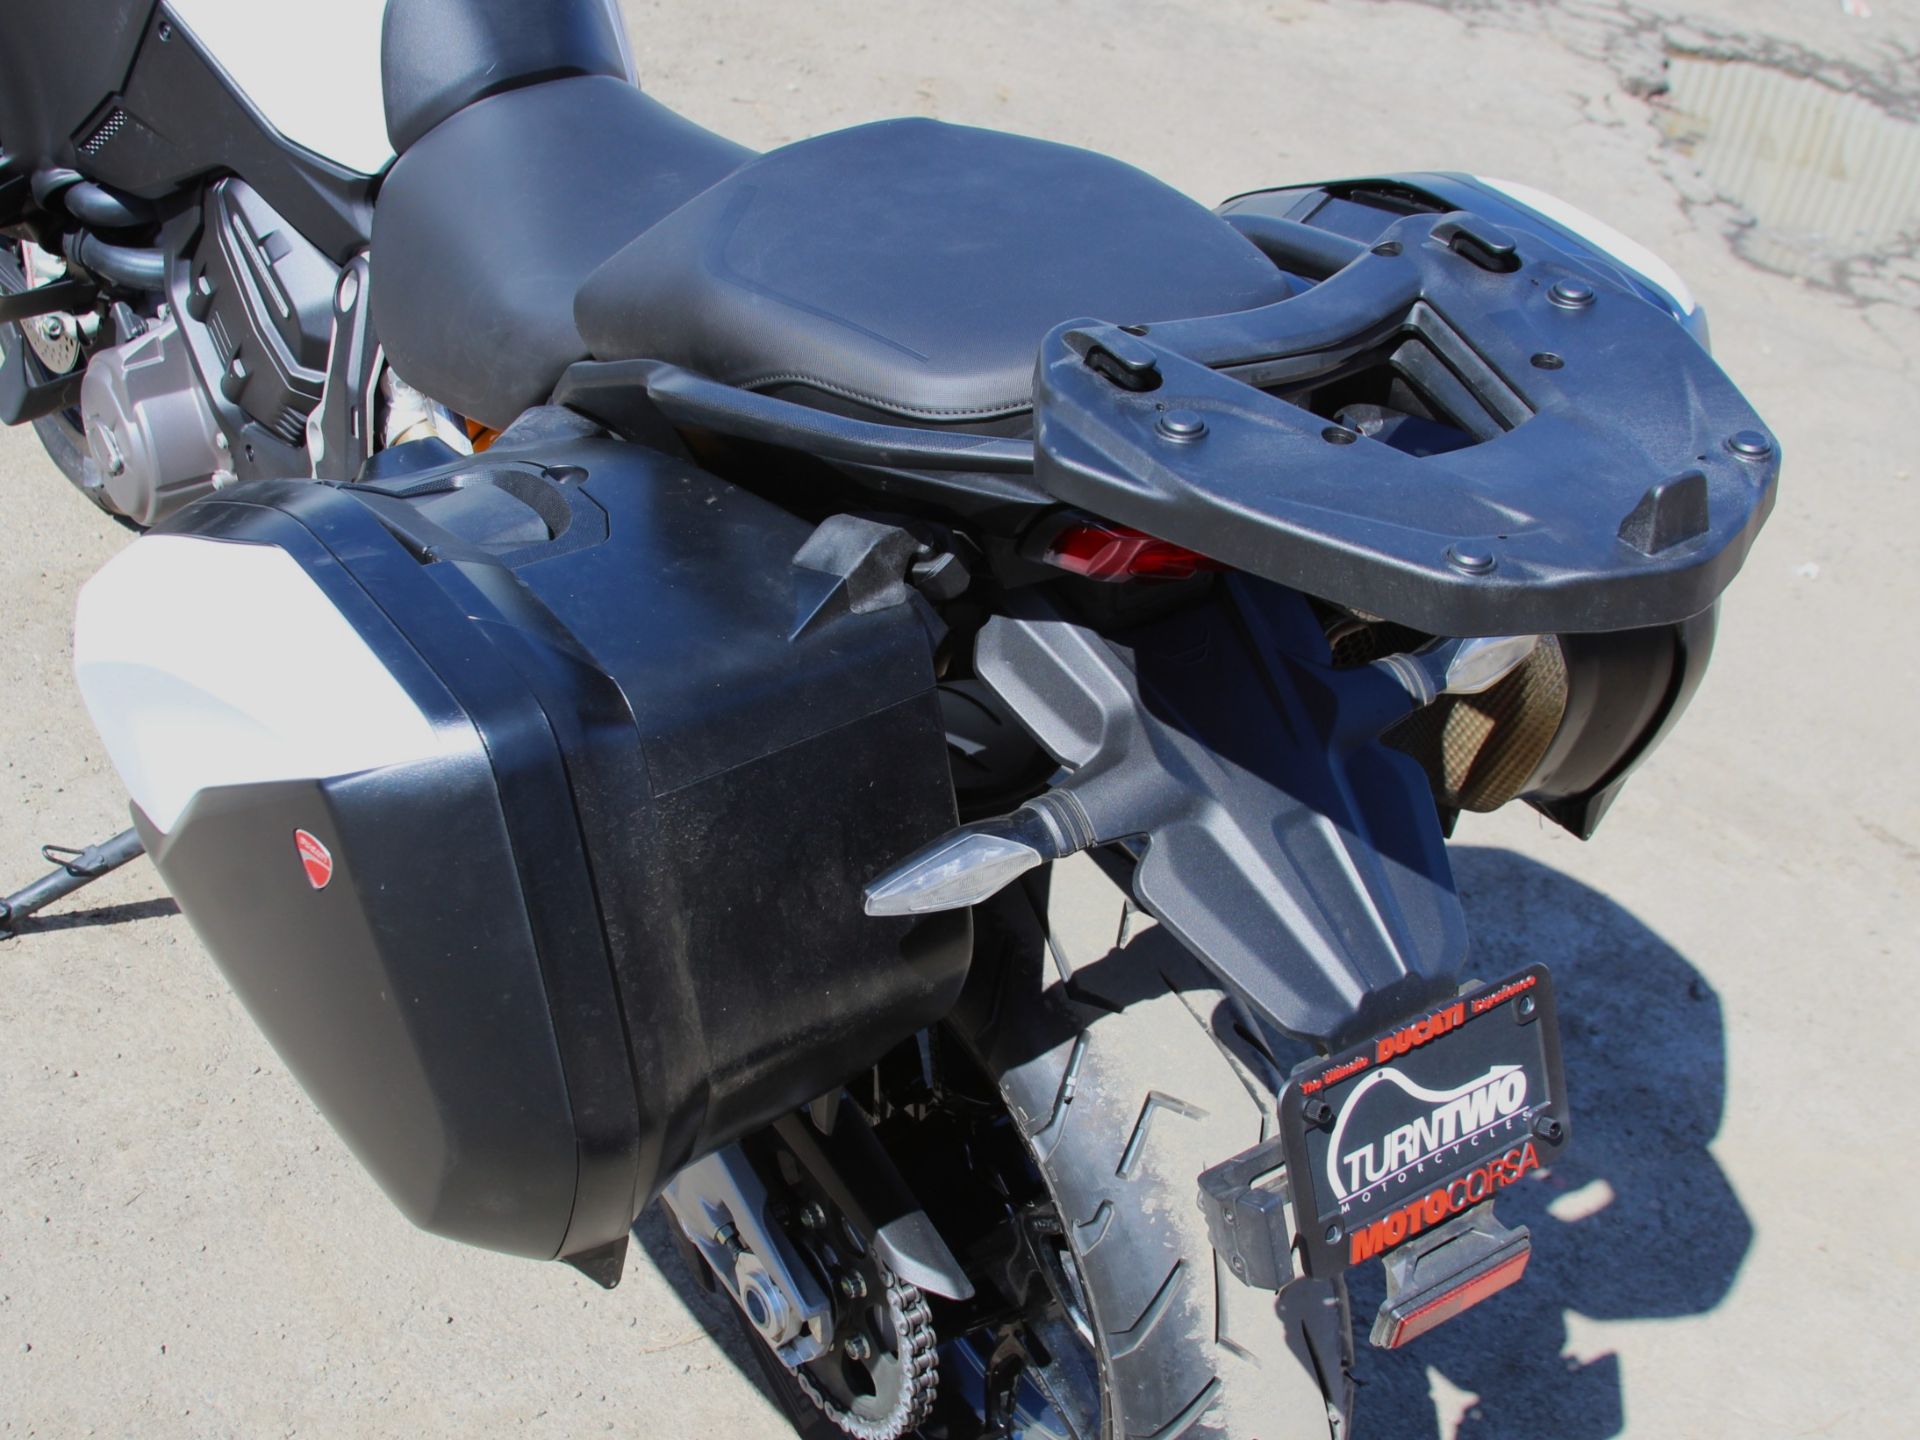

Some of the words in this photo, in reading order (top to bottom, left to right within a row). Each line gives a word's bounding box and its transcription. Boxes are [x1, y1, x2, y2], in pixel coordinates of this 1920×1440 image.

[1300, 1079, 1323, 1096] The
[1376, 1002, 1466, 1064] DUCATI
[1340, 1111, 1530, 1215] MOTORCYCLES
[1343, 1070, 1527, 1193] TURNTWO
[1350, 1142, 1540, 1265] MOTOCORSA
